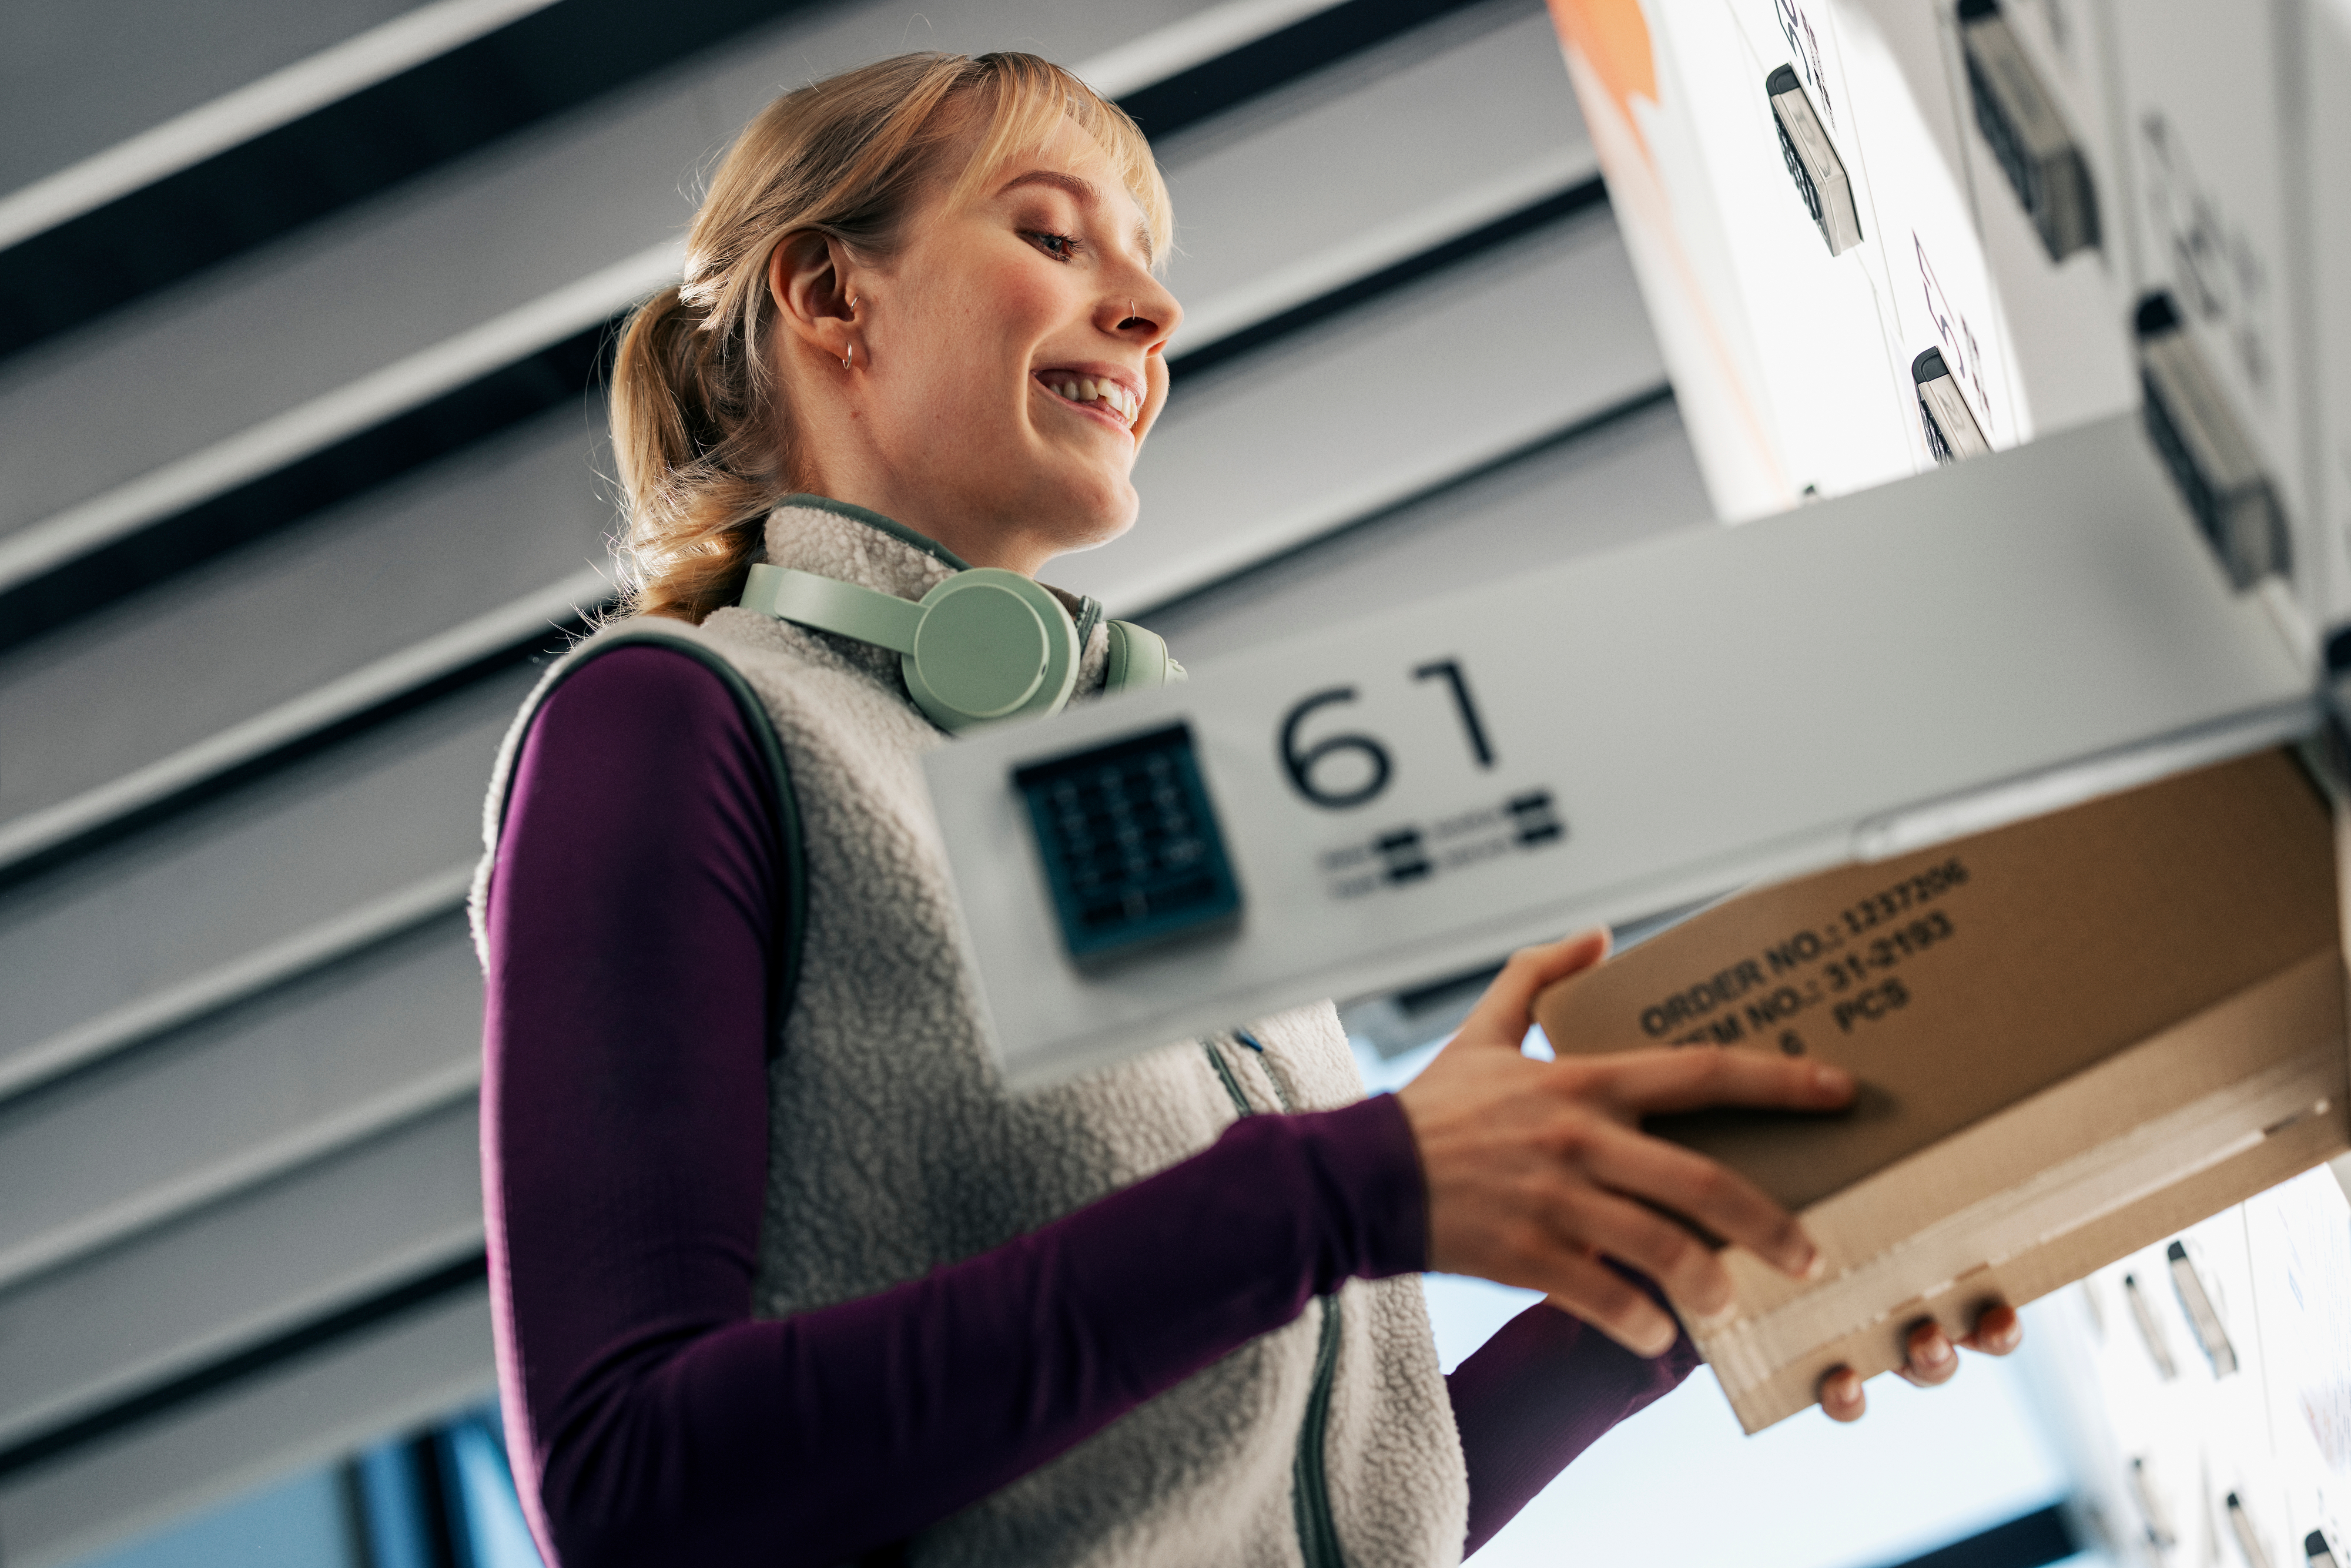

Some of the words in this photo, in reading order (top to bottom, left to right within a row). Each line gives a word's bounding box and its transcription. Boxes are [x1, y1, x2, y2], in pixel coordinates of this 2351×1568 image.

[1277, 656, 1496, 812] 61
[1640, 958, 1766, 1038] ORDER
[1832, 977, 1910, 1034] PCS
